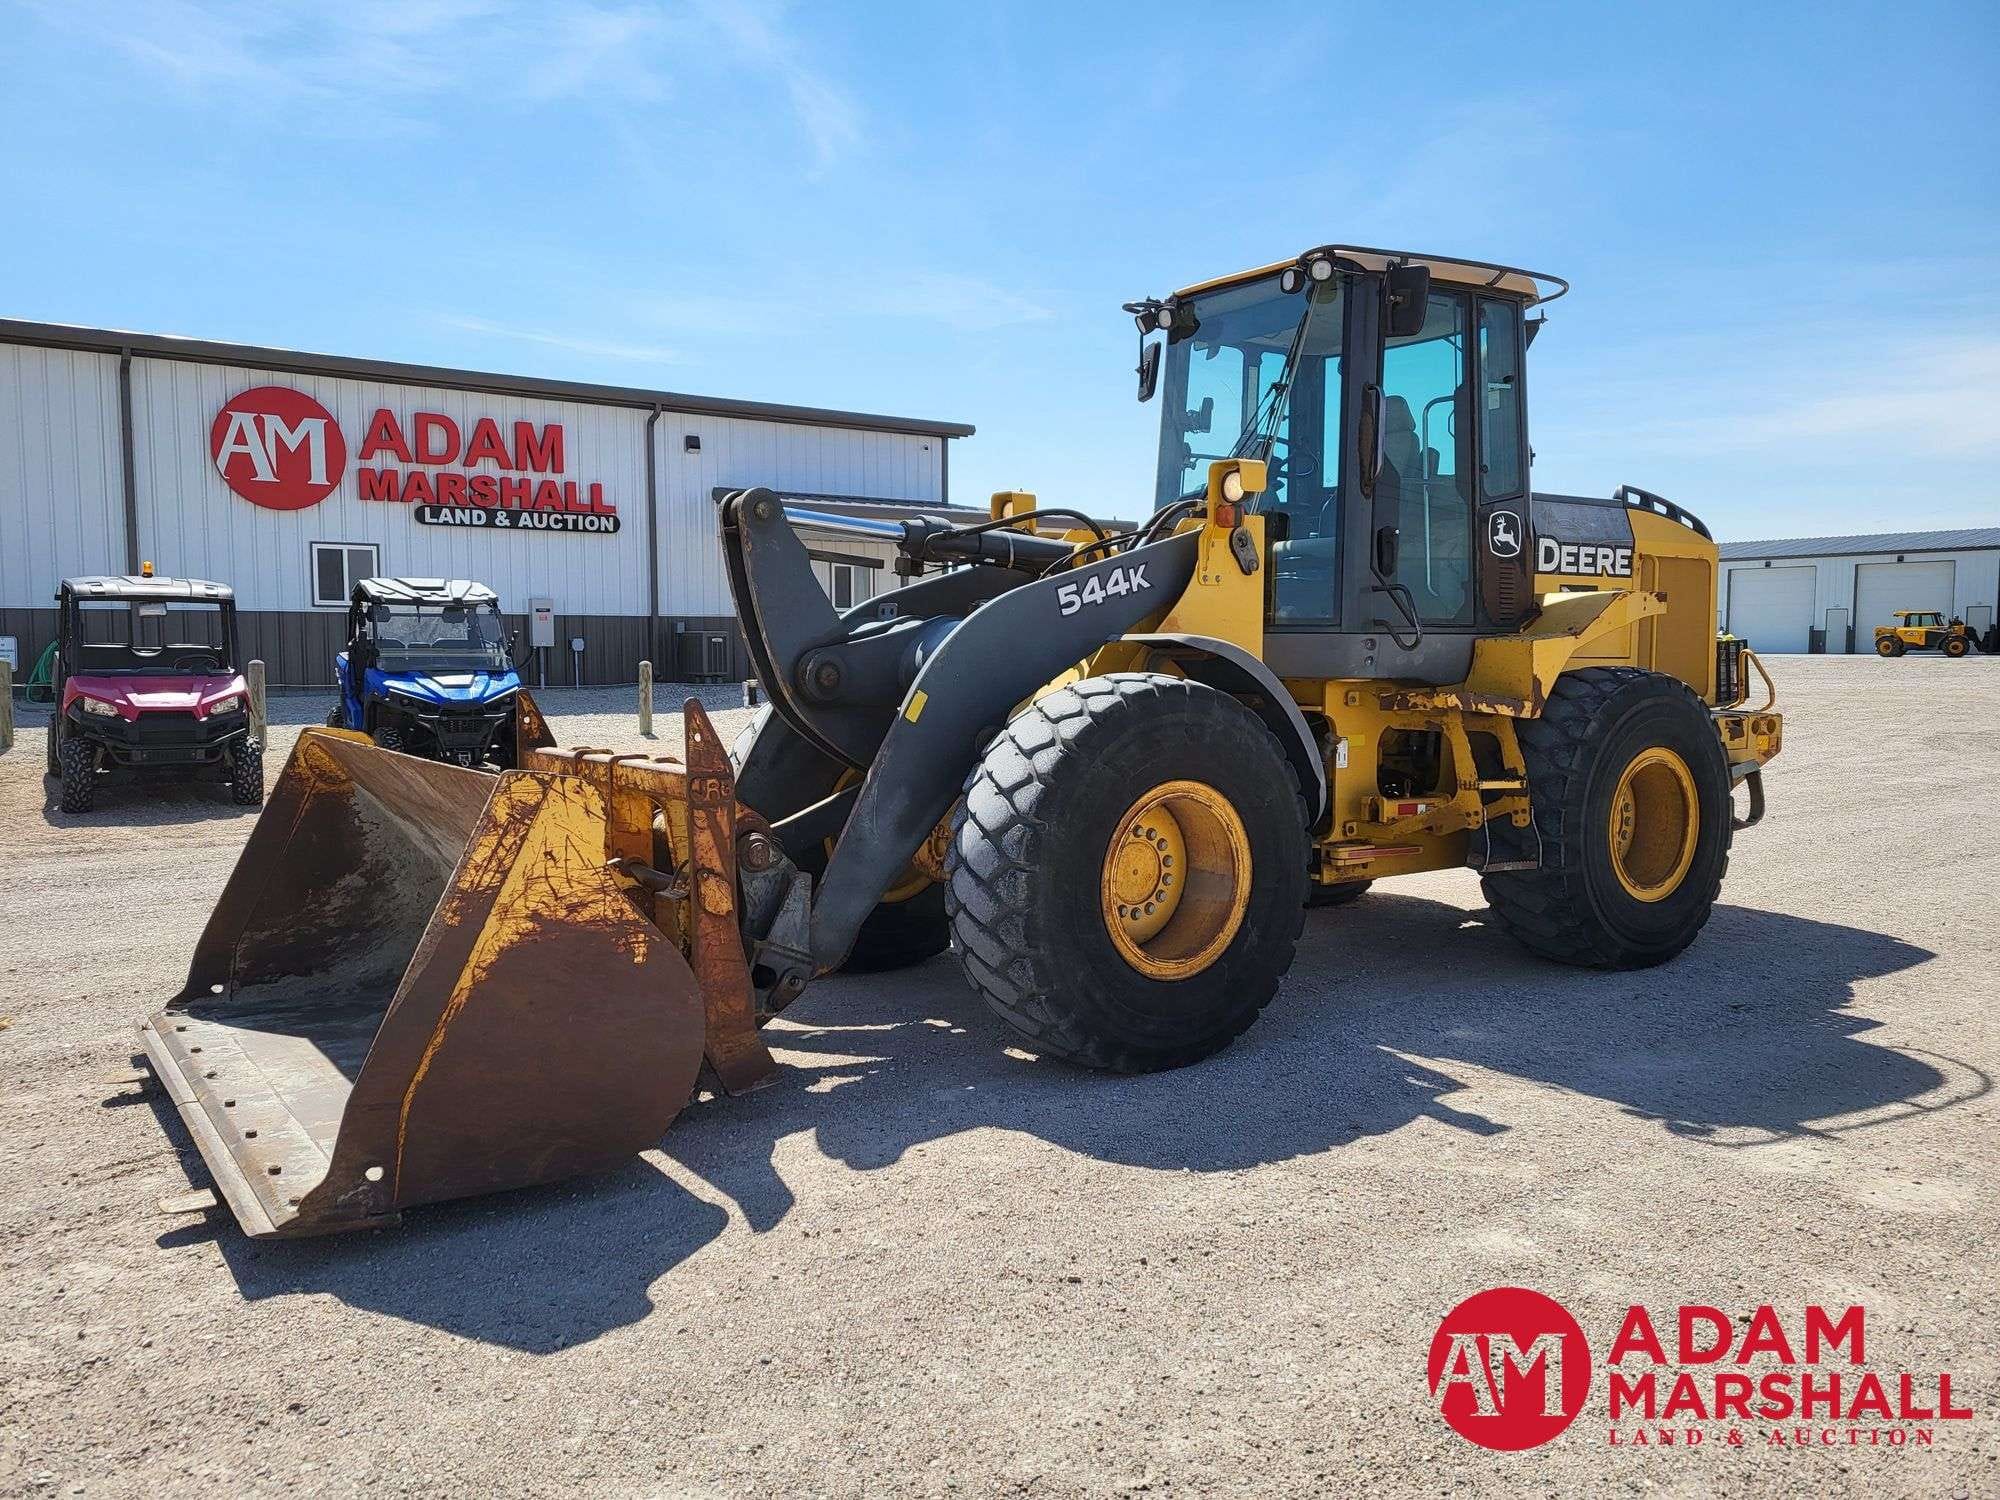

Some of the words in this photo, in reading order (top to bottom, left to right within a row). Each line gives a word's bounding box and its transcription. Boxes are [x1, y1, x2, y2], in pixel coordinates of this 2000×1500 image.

[359, 408, 564, 473] ADAM
[358, 467, 616, 514] MARSHALL
[424, 507, 487, 526] LAND
[495, 511, 511, 527] &
[517, 512, 614, 532] AUCTION
[1538, 537, 1632, 575] DEERE
[1057, 564, 1152, 616] 544K
